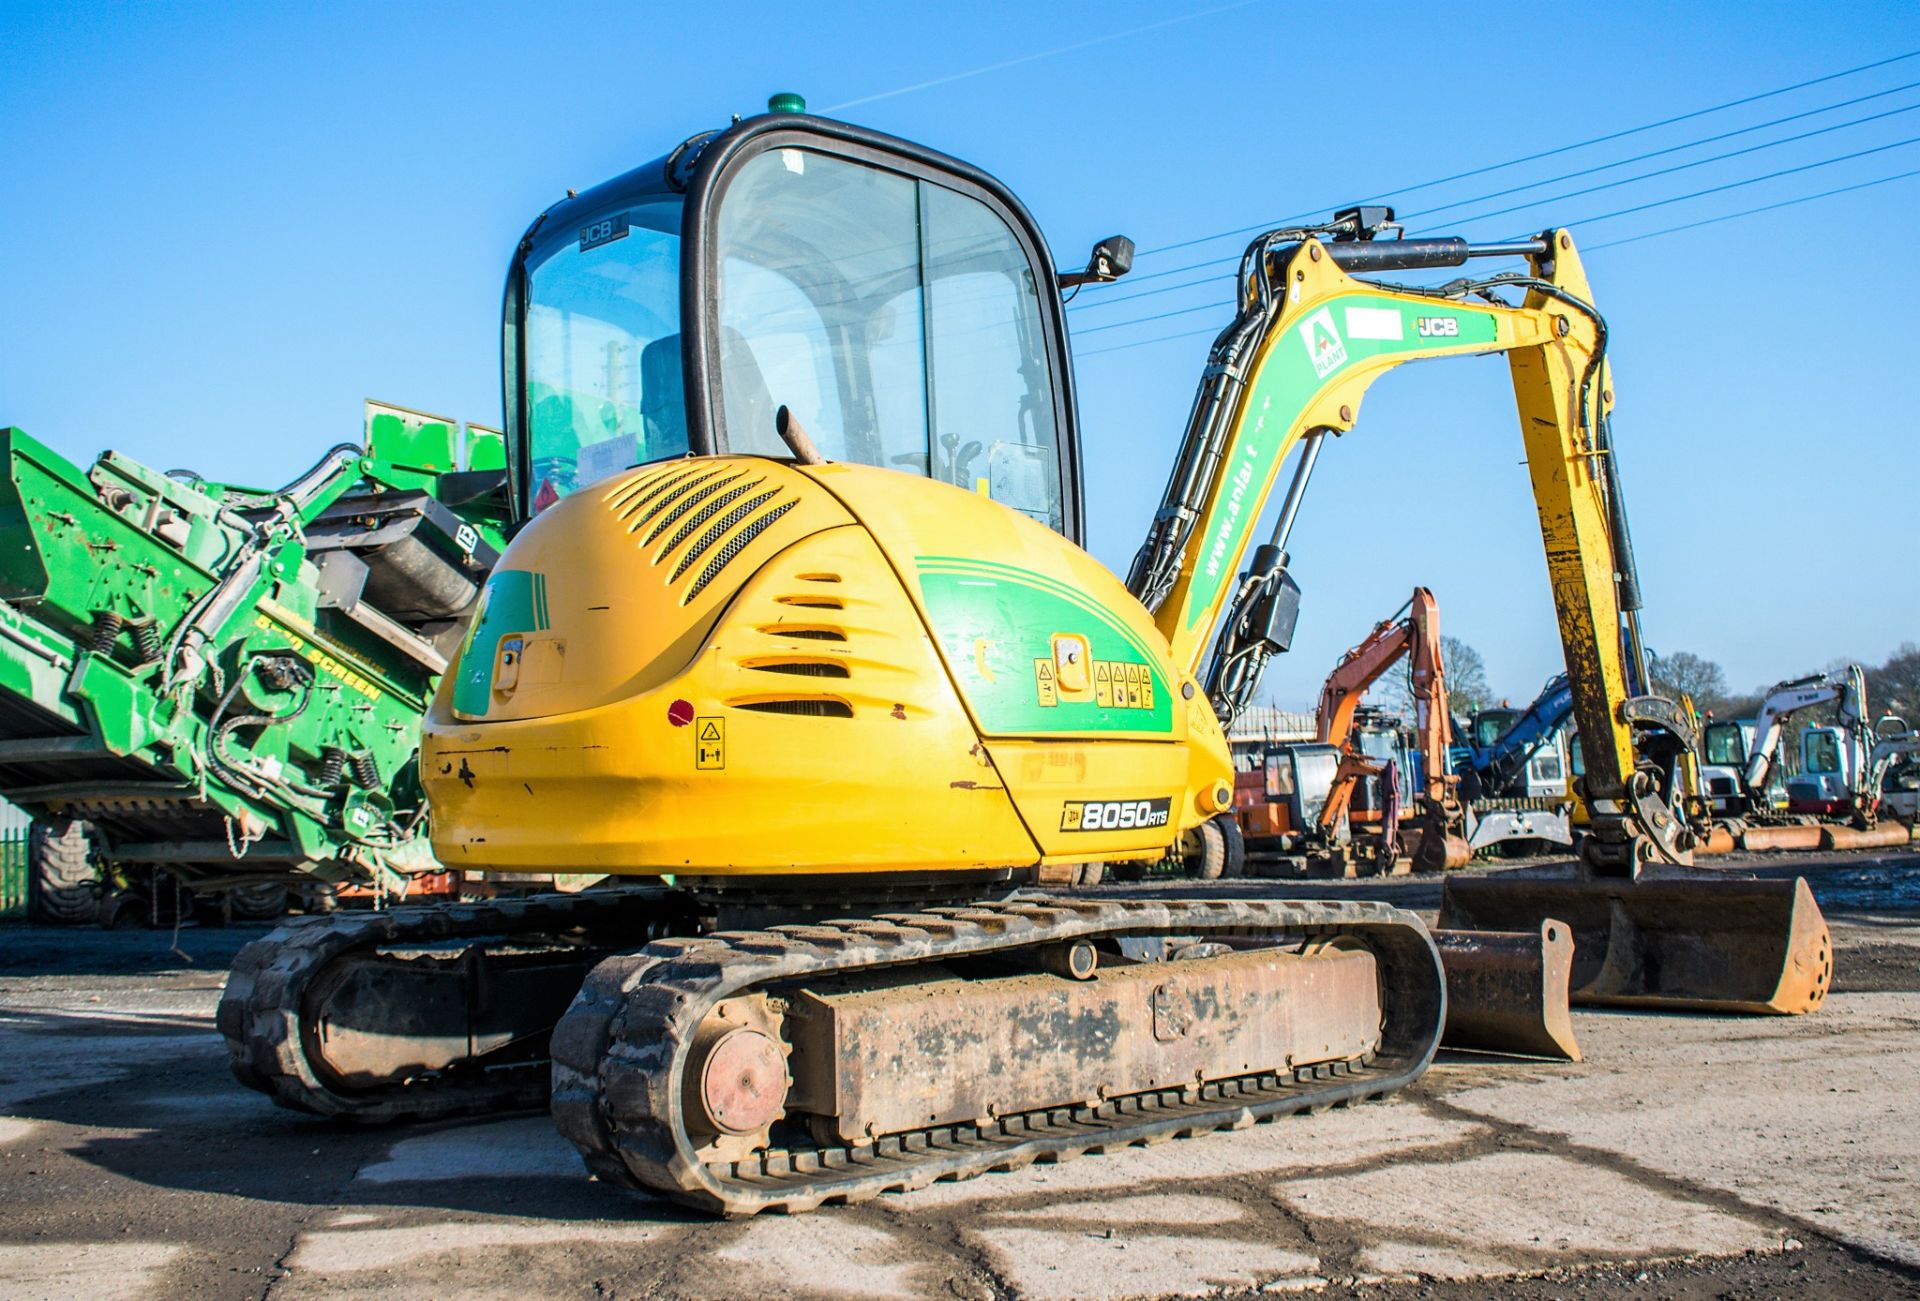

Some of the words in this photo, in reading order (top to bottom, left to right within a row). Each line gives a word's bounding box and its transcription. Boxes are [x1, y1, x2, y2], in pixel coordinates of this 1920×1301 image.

[581, 220, 612, 244] JCB
[1419, 317, 1458, 337] JCB
[1316, 346, 1346, 373] PLANT
[307, 649, 382, 701] SCREEN
